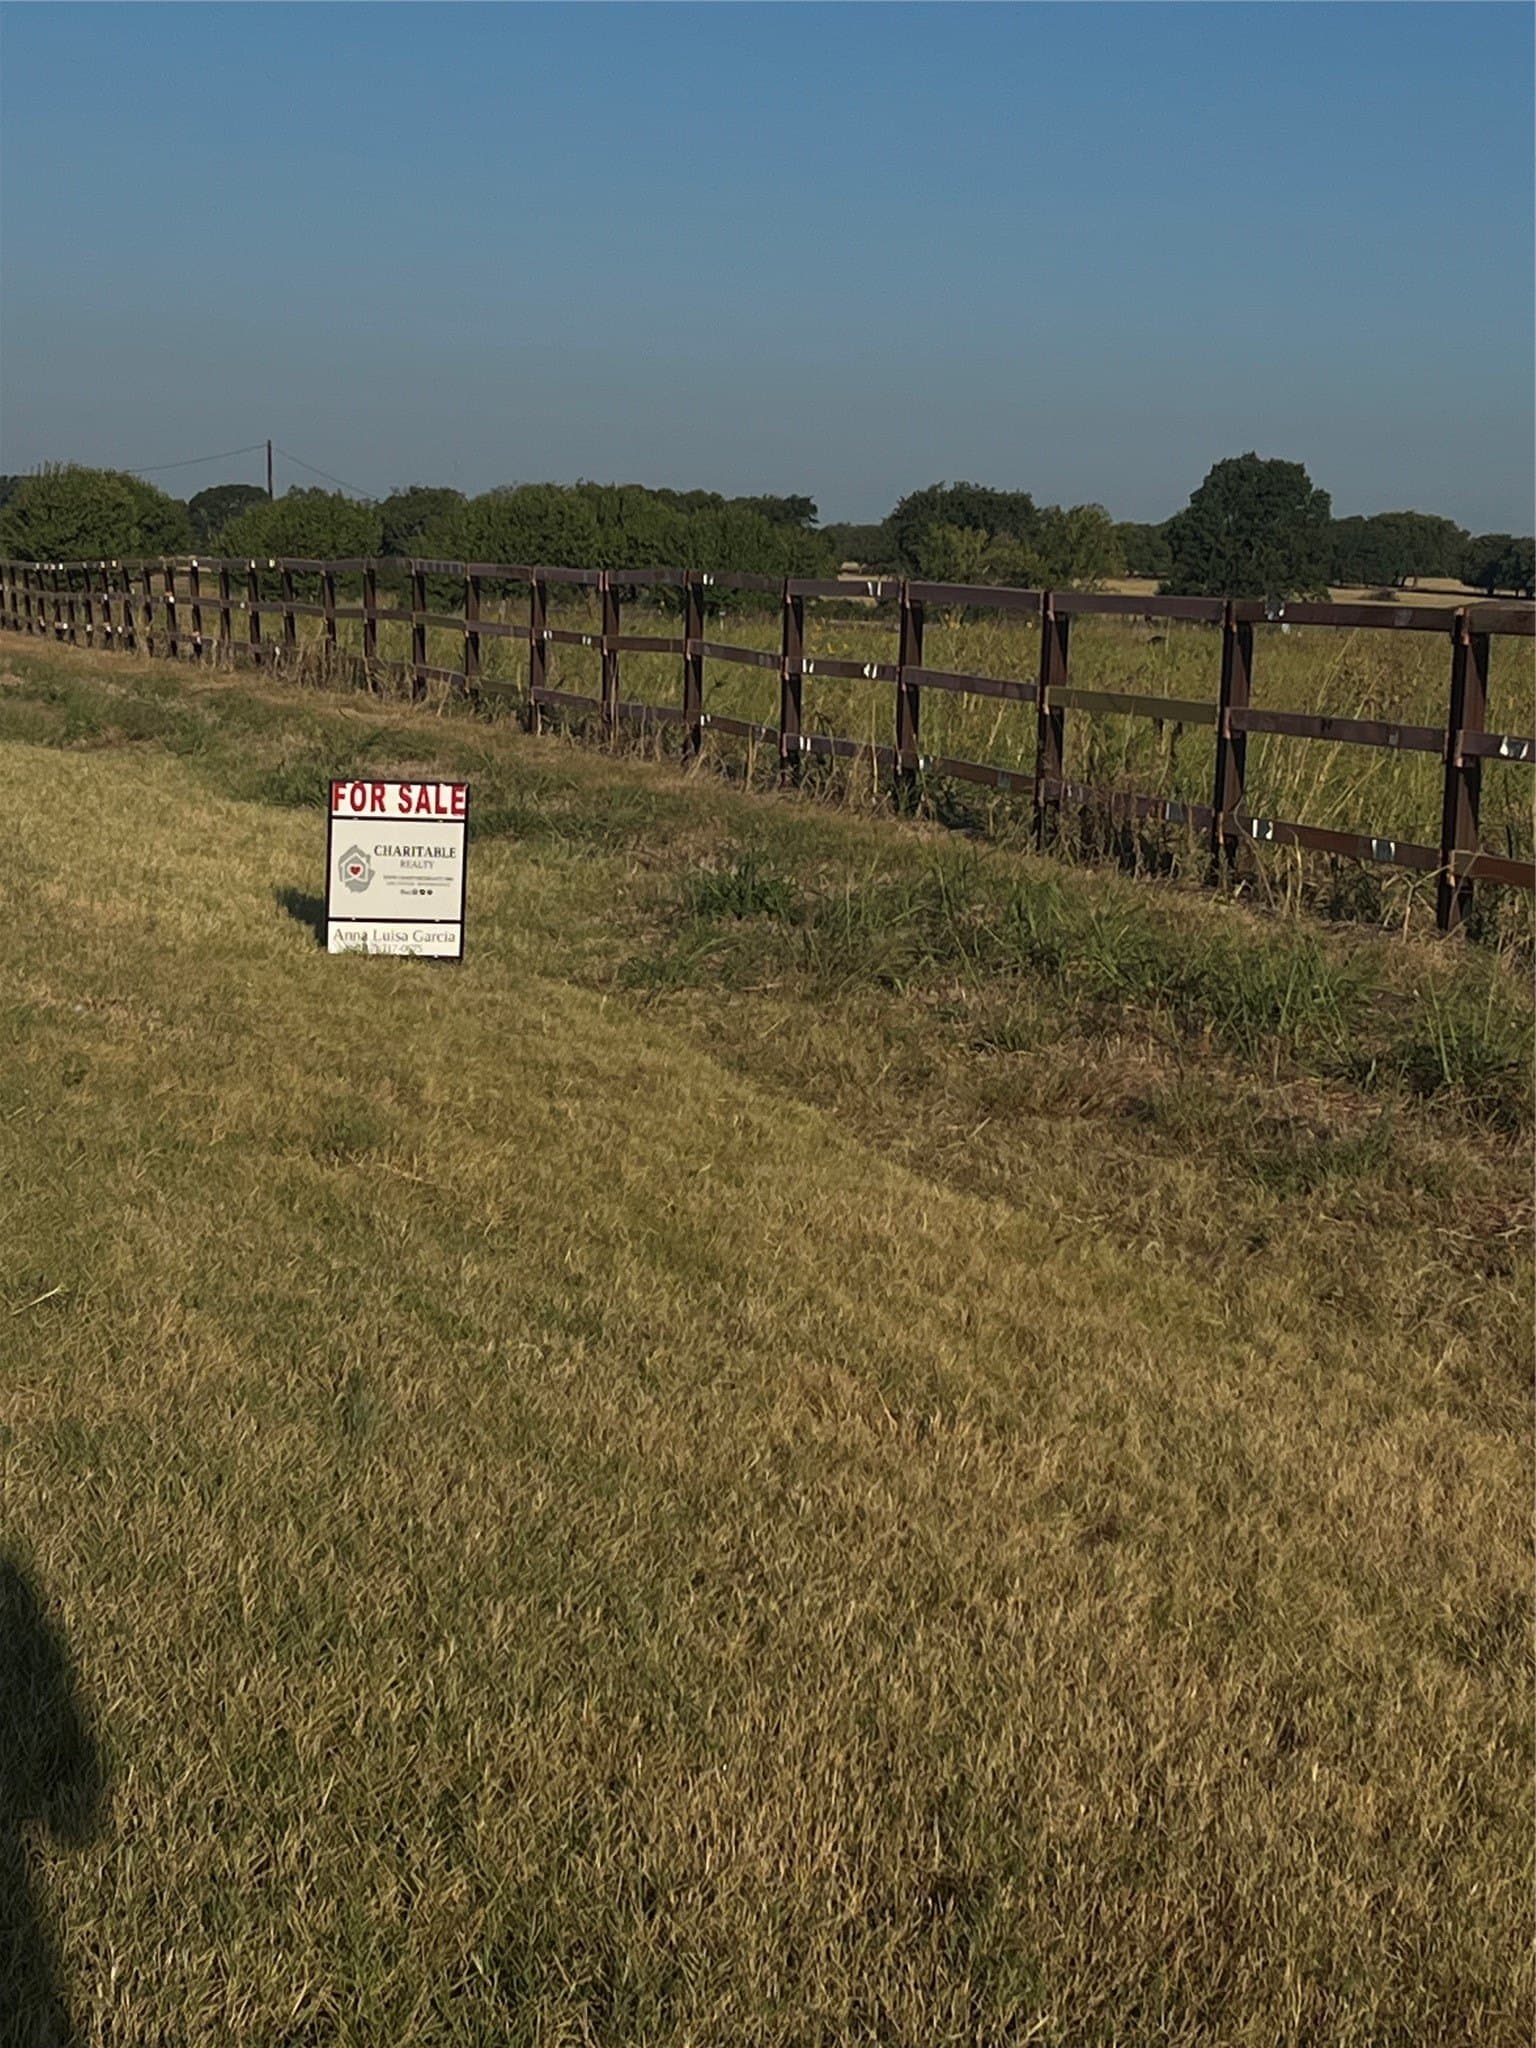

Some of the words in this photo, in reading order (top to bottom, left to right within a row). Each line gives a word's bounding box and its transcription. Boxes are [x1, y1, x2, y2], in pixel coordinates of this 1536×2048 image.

[333, 781, 386, 812] FOR
[398, 783, 465, 815] SALE
[374, 845, 456, 858] CHARITABLE
[400, 860, 434, 869] REALTY
[333, 928, 368, 941] Anna
[373, 929, 408, 941] Luisa
[412, 930, 455, 943] Garcia
